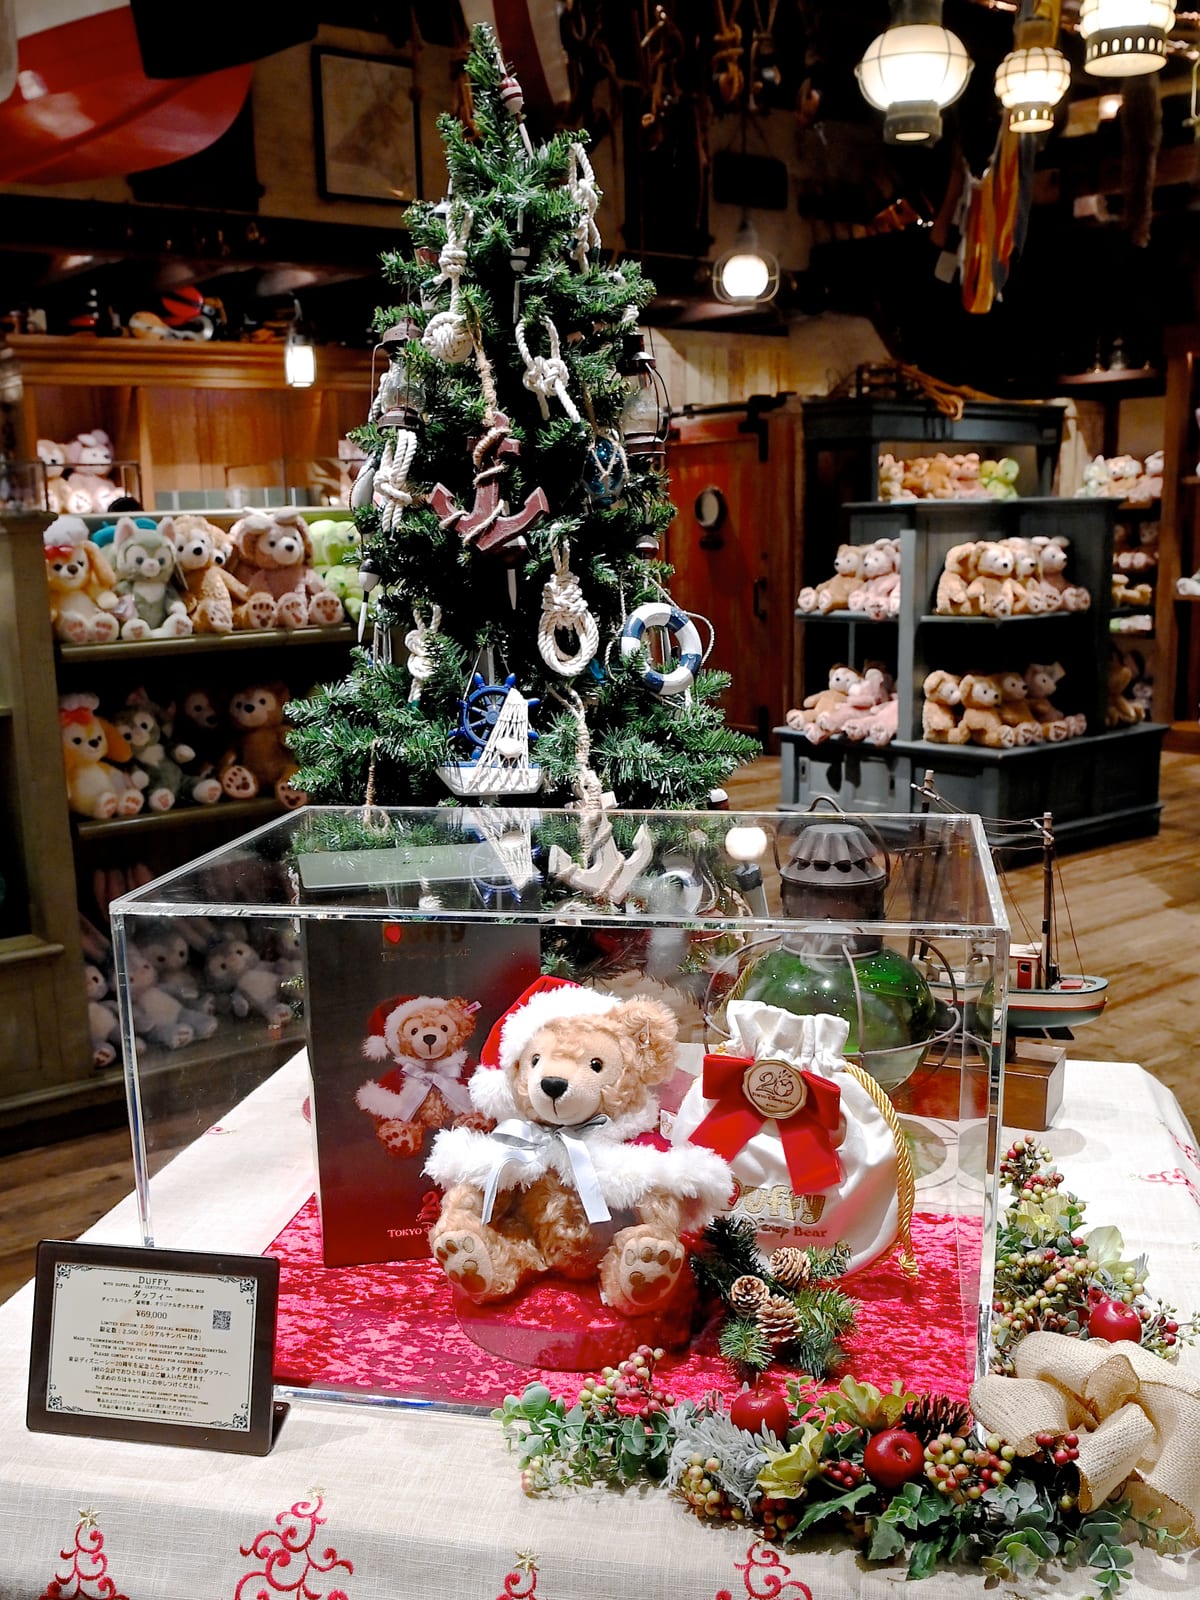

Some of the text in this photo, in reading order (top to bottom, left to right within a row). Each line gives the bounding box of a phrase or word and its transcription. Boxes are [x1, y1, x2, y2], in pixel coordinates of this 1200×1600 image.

[387, 1227, 423, 1238] TOKYO
[793, 1225, 828, 1237] Bear
[138, 1276, 169, 1286] DUFFY
[133, 1289, 173, 1301] ダッフィー
[136, 1310, 167, 1320] ¥69,000
